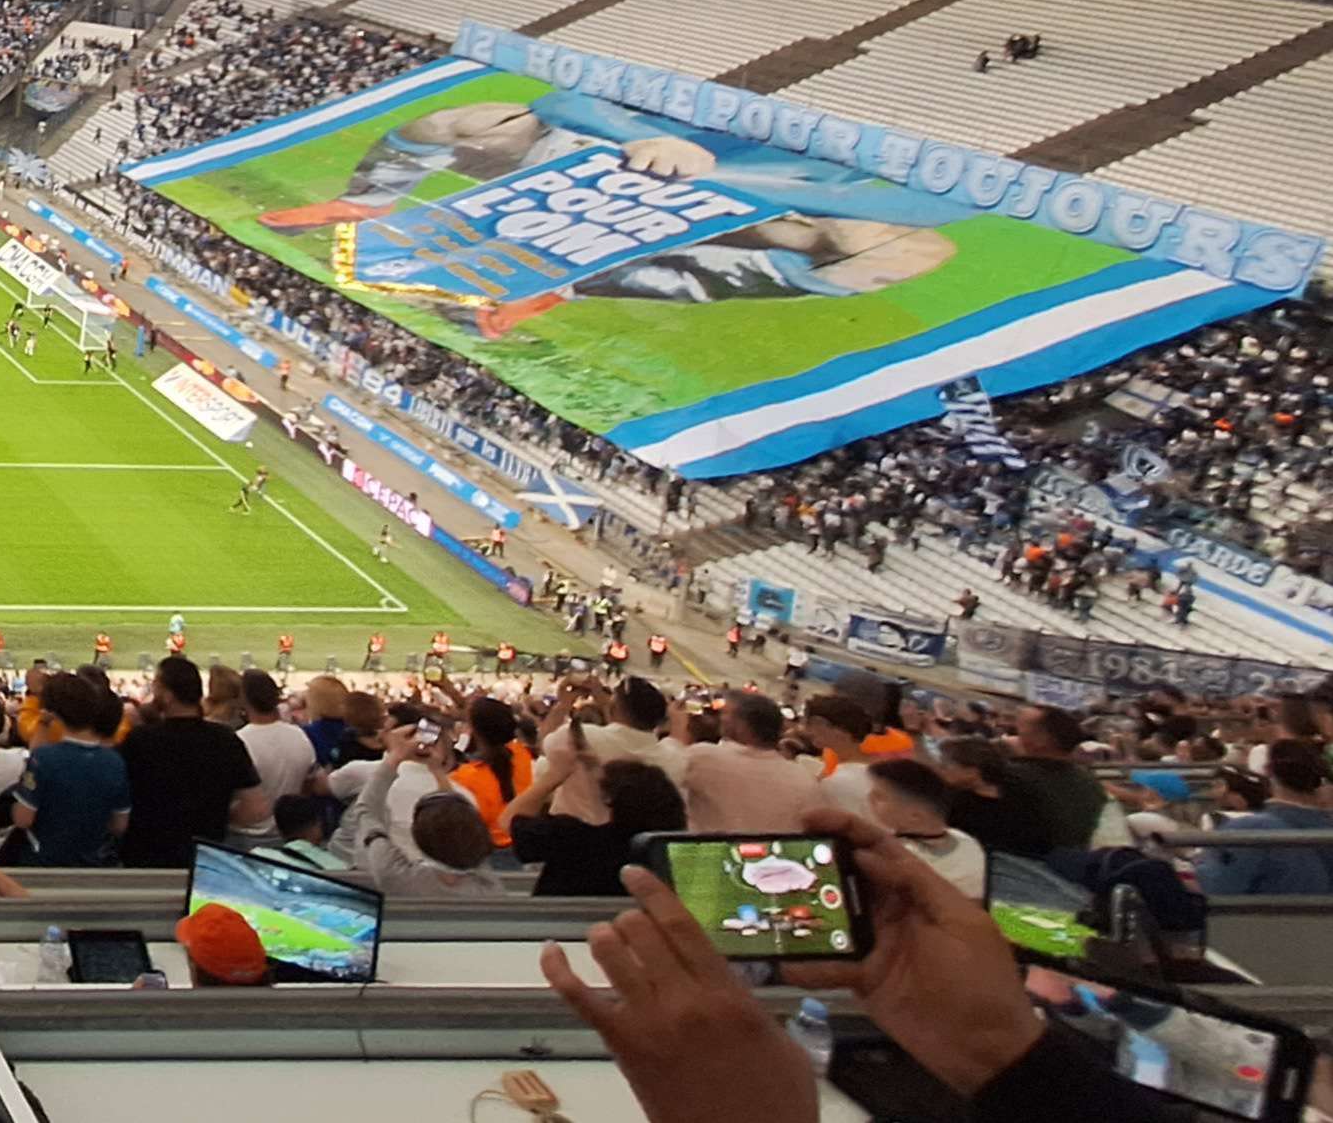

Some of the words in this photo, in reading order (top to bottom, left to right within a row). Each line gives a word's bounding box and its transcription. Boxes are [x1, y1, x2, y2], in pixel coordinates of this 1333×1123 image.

[524, 39, 701, 124] HOMME
[705, 83, 862, 166] POUR
[880, 131, 1322, 291] TOUJOURS
[567, 153, 757, 222] TOUT
[451, 188, 640, 266] L'OM
[513, 170, 690, 243] POUR
